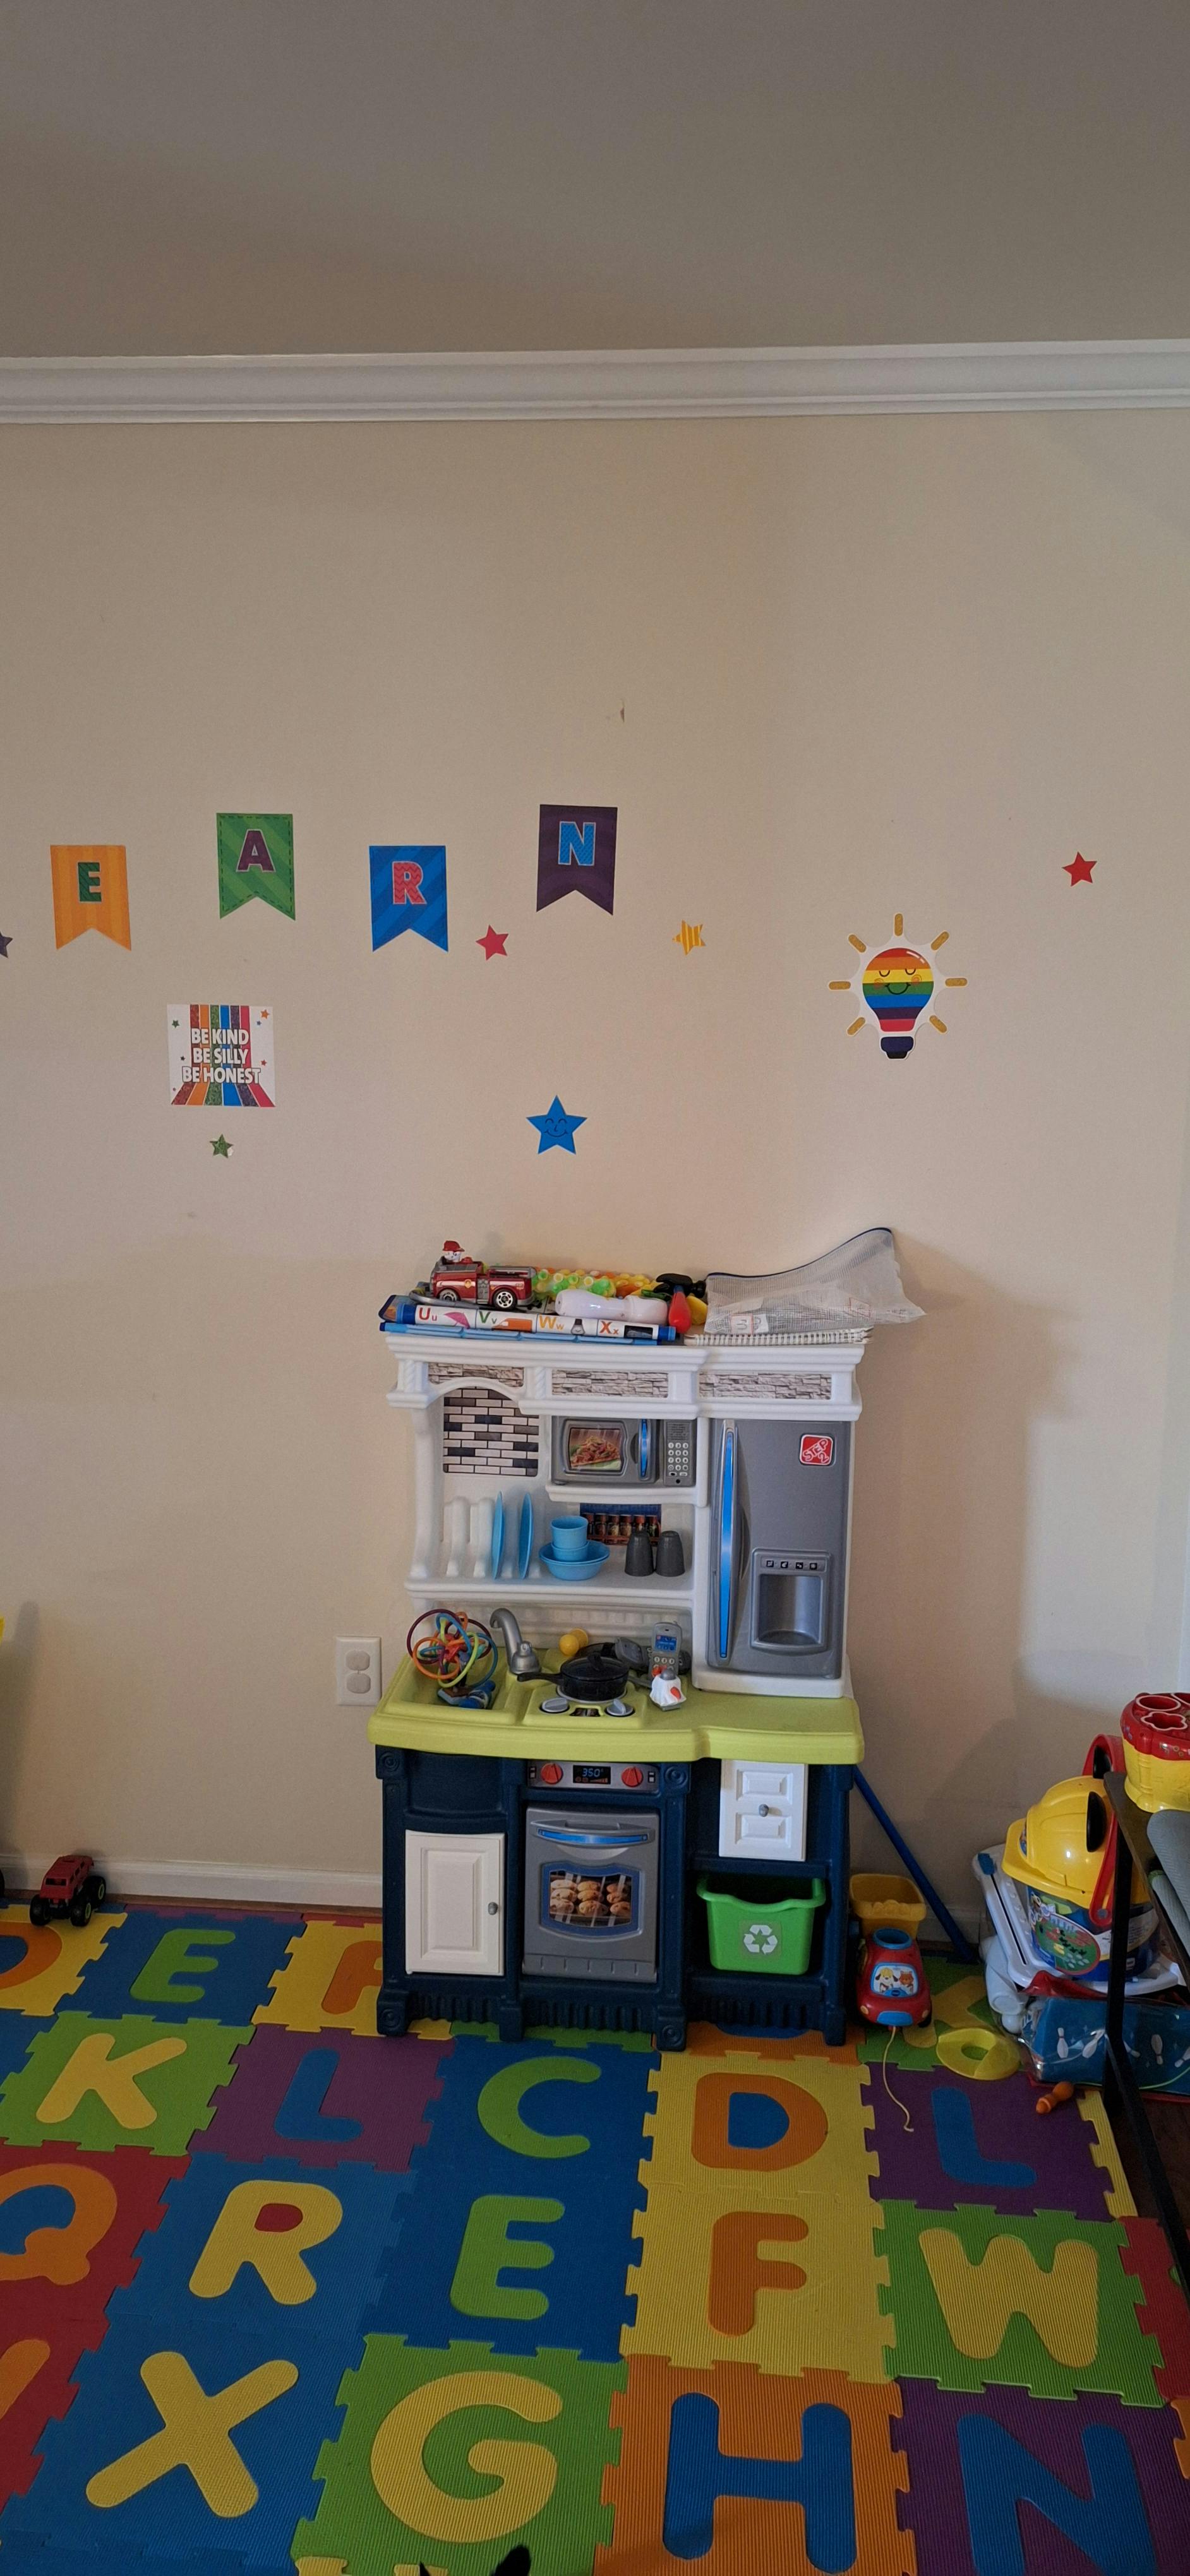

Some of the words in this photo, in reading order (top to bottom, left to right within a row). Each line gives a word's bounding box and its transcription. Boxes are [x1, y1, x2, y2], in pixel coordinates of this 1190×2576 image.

[78, 861, 102, 903] E
[236, 829, 275, 872] A
[393, 861, 426, 905] R
[558, 821, 596, 866] N
[191, 1028, 209, 1044] BE
[212, 1029, 249, 1045] KIND
[193, 1047, 210, 1064] BE
[213, 1048, 249, 1064] SILLY
[182, 1066, 200, 1083] BE
[203, 1067, 261, 1084] HONEST
[803, 1439, 828, 1461] STEP
[818, 1452, 829, 1462] 2
[129, 1928, 236, 2004] E
[36, 2032, 188, 2130] K
[273, 2048, 363, 2141] L
[478, 2056, 602, 2159] C
[691, 2072, 829, 2172] D
[931, 2086, 1038, 2188] L
[189, 2179, 344, 2305] R
[450, 2194, 565, 2320] E
[708, 2211, 810, 2337] F
[918, 2227, 1100, 2368] W
[86, 2350, 299, 2519] X
[371, 2370, 563, 2543] G
[662, 2391, 858, 2575] H
[956, 2413, 1158, 2576] N
